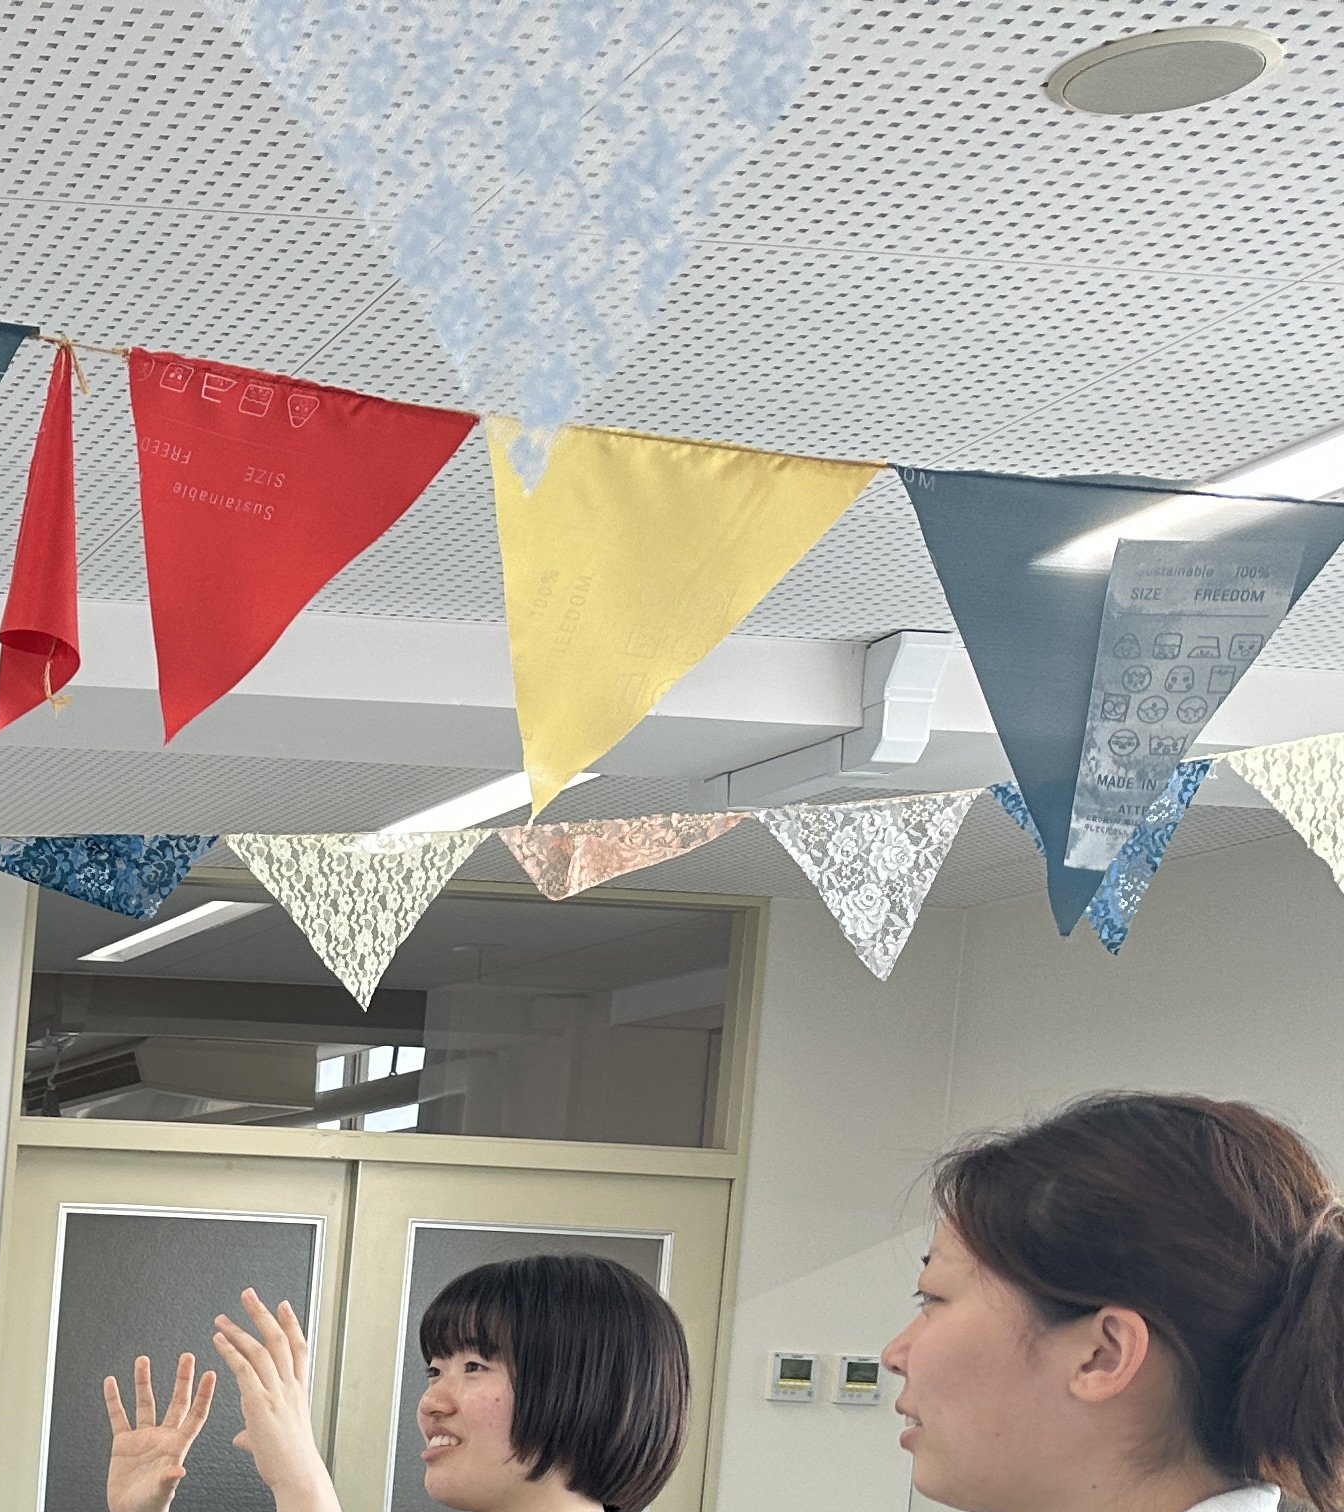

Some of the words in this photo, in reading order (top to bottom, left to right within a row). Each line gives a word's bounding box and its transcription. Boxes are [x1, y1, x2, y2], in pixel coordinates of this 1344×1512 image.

[243, 466, 285, 489] SIZE
[173, 482, 274, 521] Sustainable
[1136, 564, 1214, 580] Sustainable
[1232, 565, 1270, 581] 100%
[1131, 587, 1163, 602] SIZE
[1193, 588, 1266, 603] FREEDOM
[1096, 774, 1132, 791] MADE
[1142, 778, 1158, 791] IN
